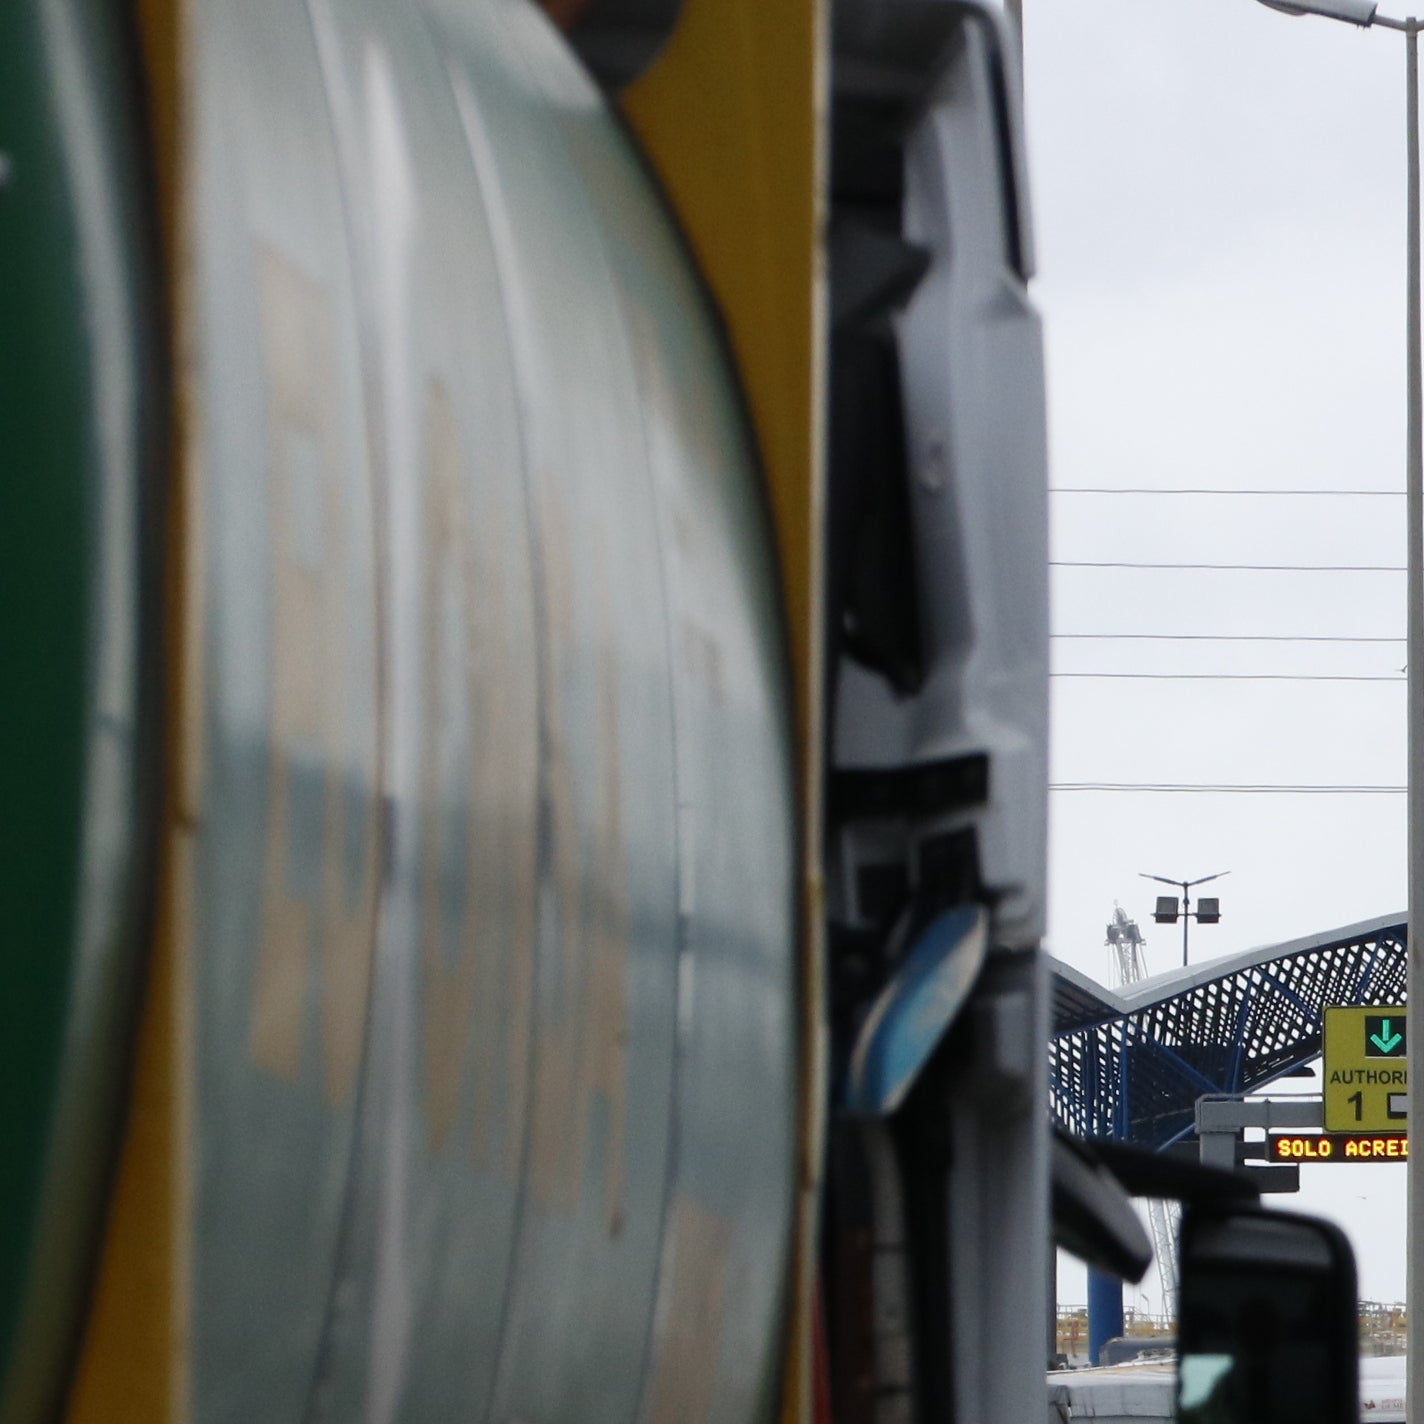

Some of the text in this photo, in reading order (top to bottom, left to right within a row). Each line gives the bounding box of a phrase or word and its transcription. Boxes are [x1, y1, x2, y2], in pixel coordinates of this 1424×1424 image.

[1329, 1069, 1407, 1085] AUTHORI
[1347, 1090, 1363, 1122] 1
[1277, 1138, 1332, 1157] SOLO
